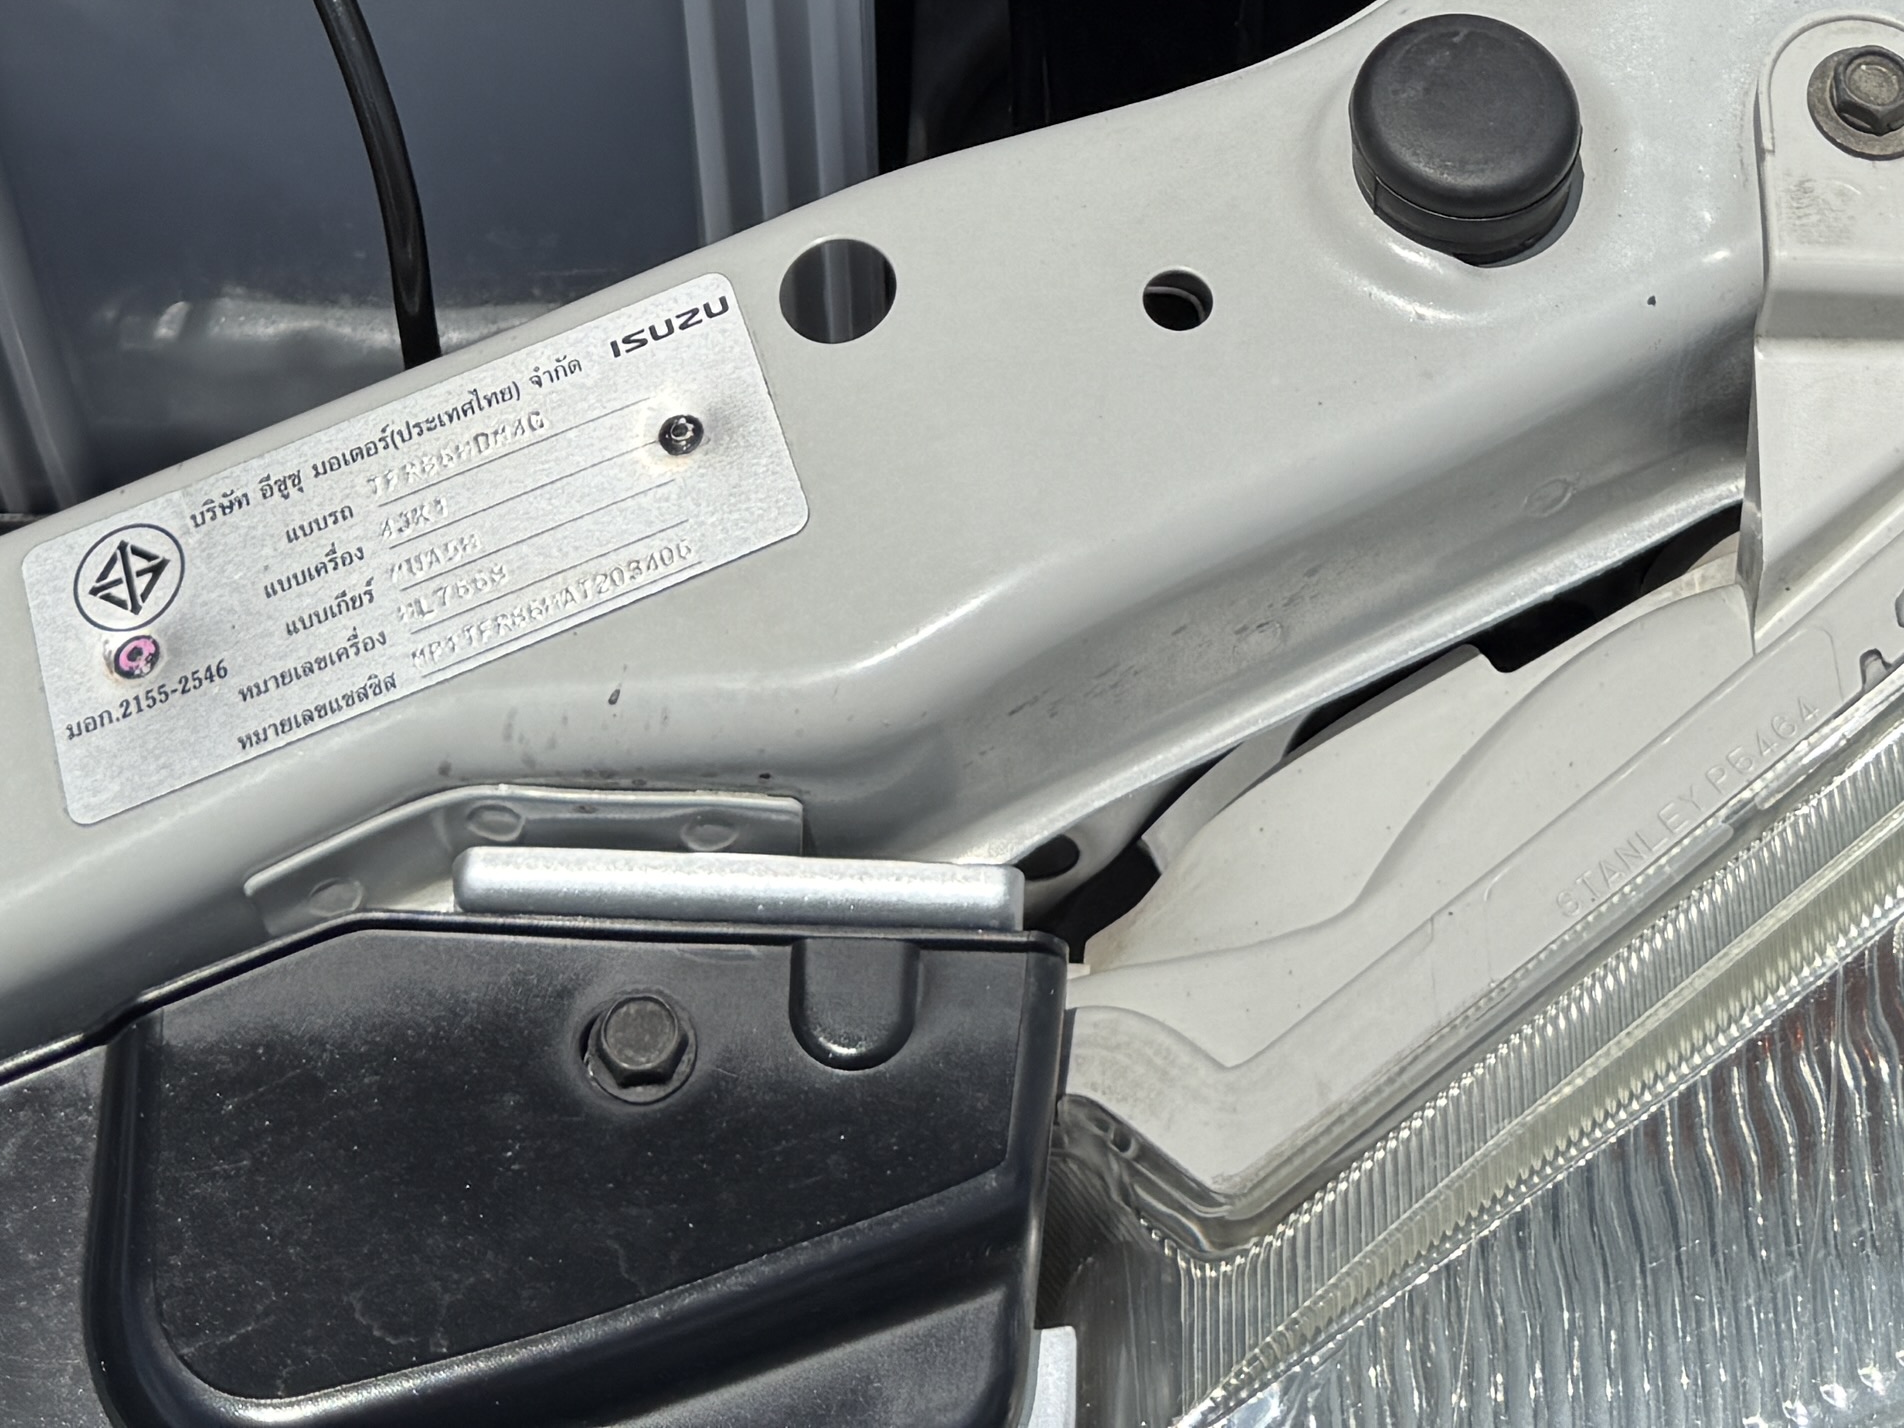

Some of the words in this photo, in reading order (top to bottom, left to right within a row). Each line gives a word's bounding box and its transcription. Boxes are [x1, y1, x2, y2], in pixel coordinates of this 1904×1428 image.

[609, 294, 732, 359] ISUZU
[189, 487, 252, 530] บริษัท
[312, 380, 521, 478] มอเตอร์(ประเทศไทย)
[528, 352, 583, 391] จำกัด
[284, 502, 355, 545] แบบรถ
[262, 540, 366, 600] แบบเครื่อง
[284, 576, 376, 637] แบบเกียร์
[65, 659, 229, 741] มอก.2155-2546
[237, 627, 388, 704] หมายเลขเครื่อง
[1556, 784, 1703, 918] STANLEY
[1705, 696, 1820, 793] P5464
